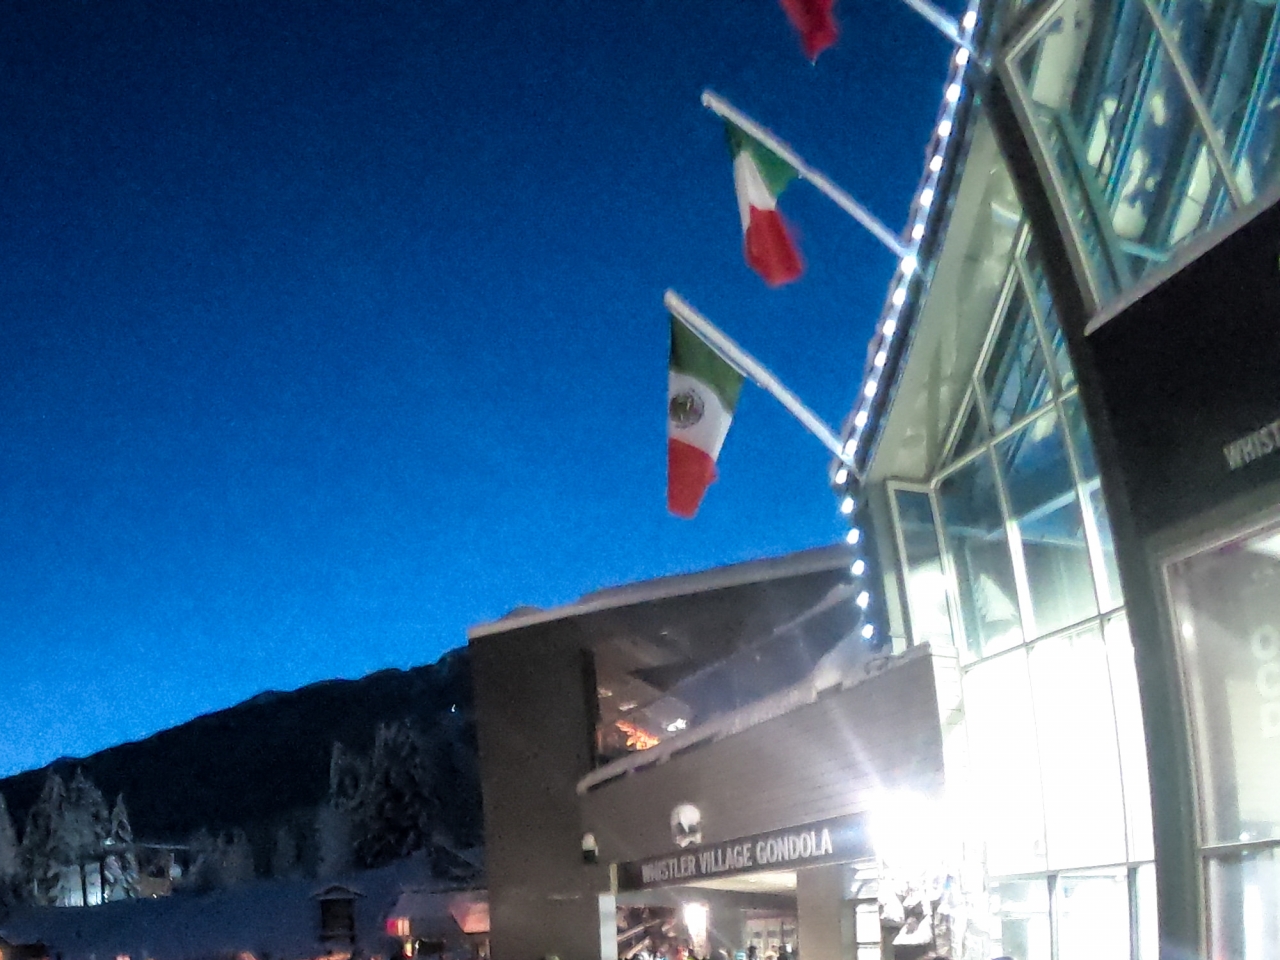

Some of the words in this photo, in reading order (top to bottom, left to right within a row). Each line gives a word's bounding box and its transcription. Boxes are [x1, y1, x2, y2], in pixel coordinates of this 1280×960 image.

[641, 855, 696, 883] WHISTLER
[698, 843, 753, 874] VILLAGE
[756, 828, 832, 864] GONDOLA
